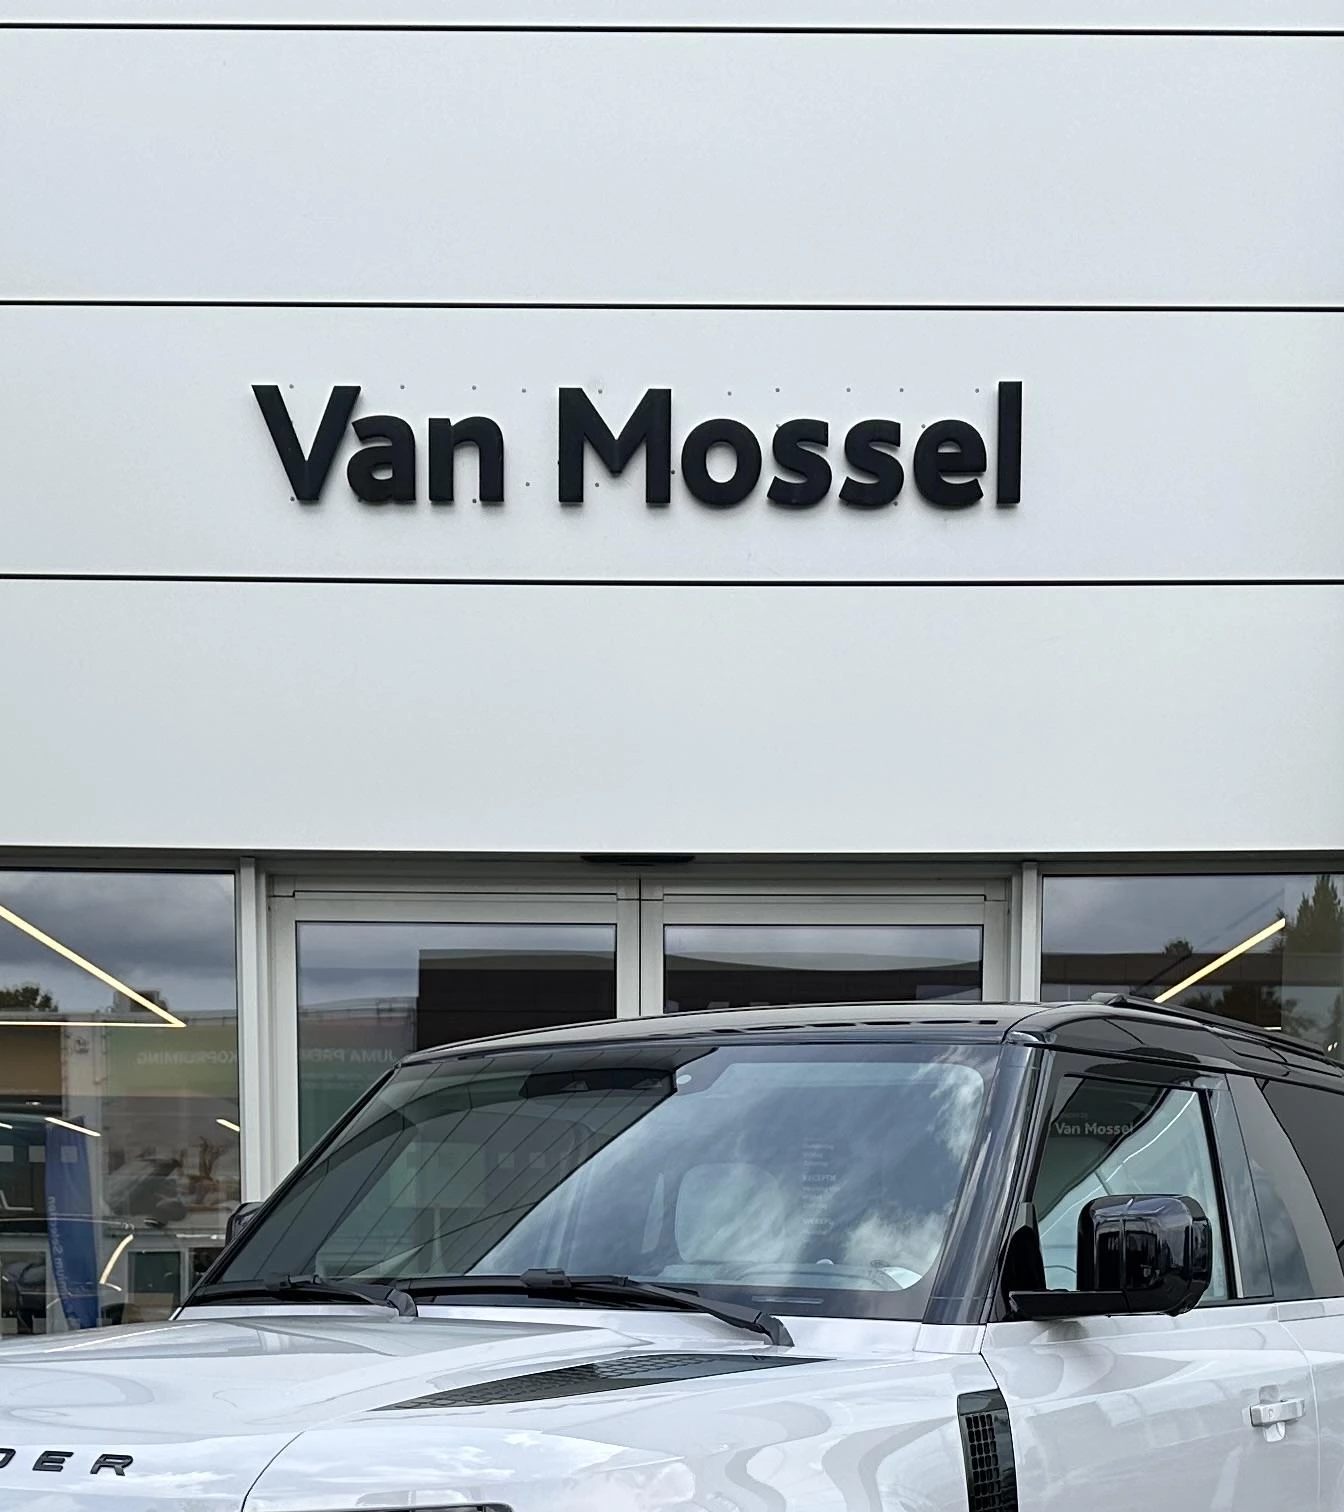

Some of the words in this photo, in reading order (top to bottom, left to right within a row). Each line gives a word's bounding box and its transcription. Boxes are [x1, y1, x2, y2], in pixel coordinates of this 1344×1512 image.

[251, 384, 505, 504] Van
[558, 381, 1023, 509] Mossel
[1054, 1122, 1081, 1135] Van
